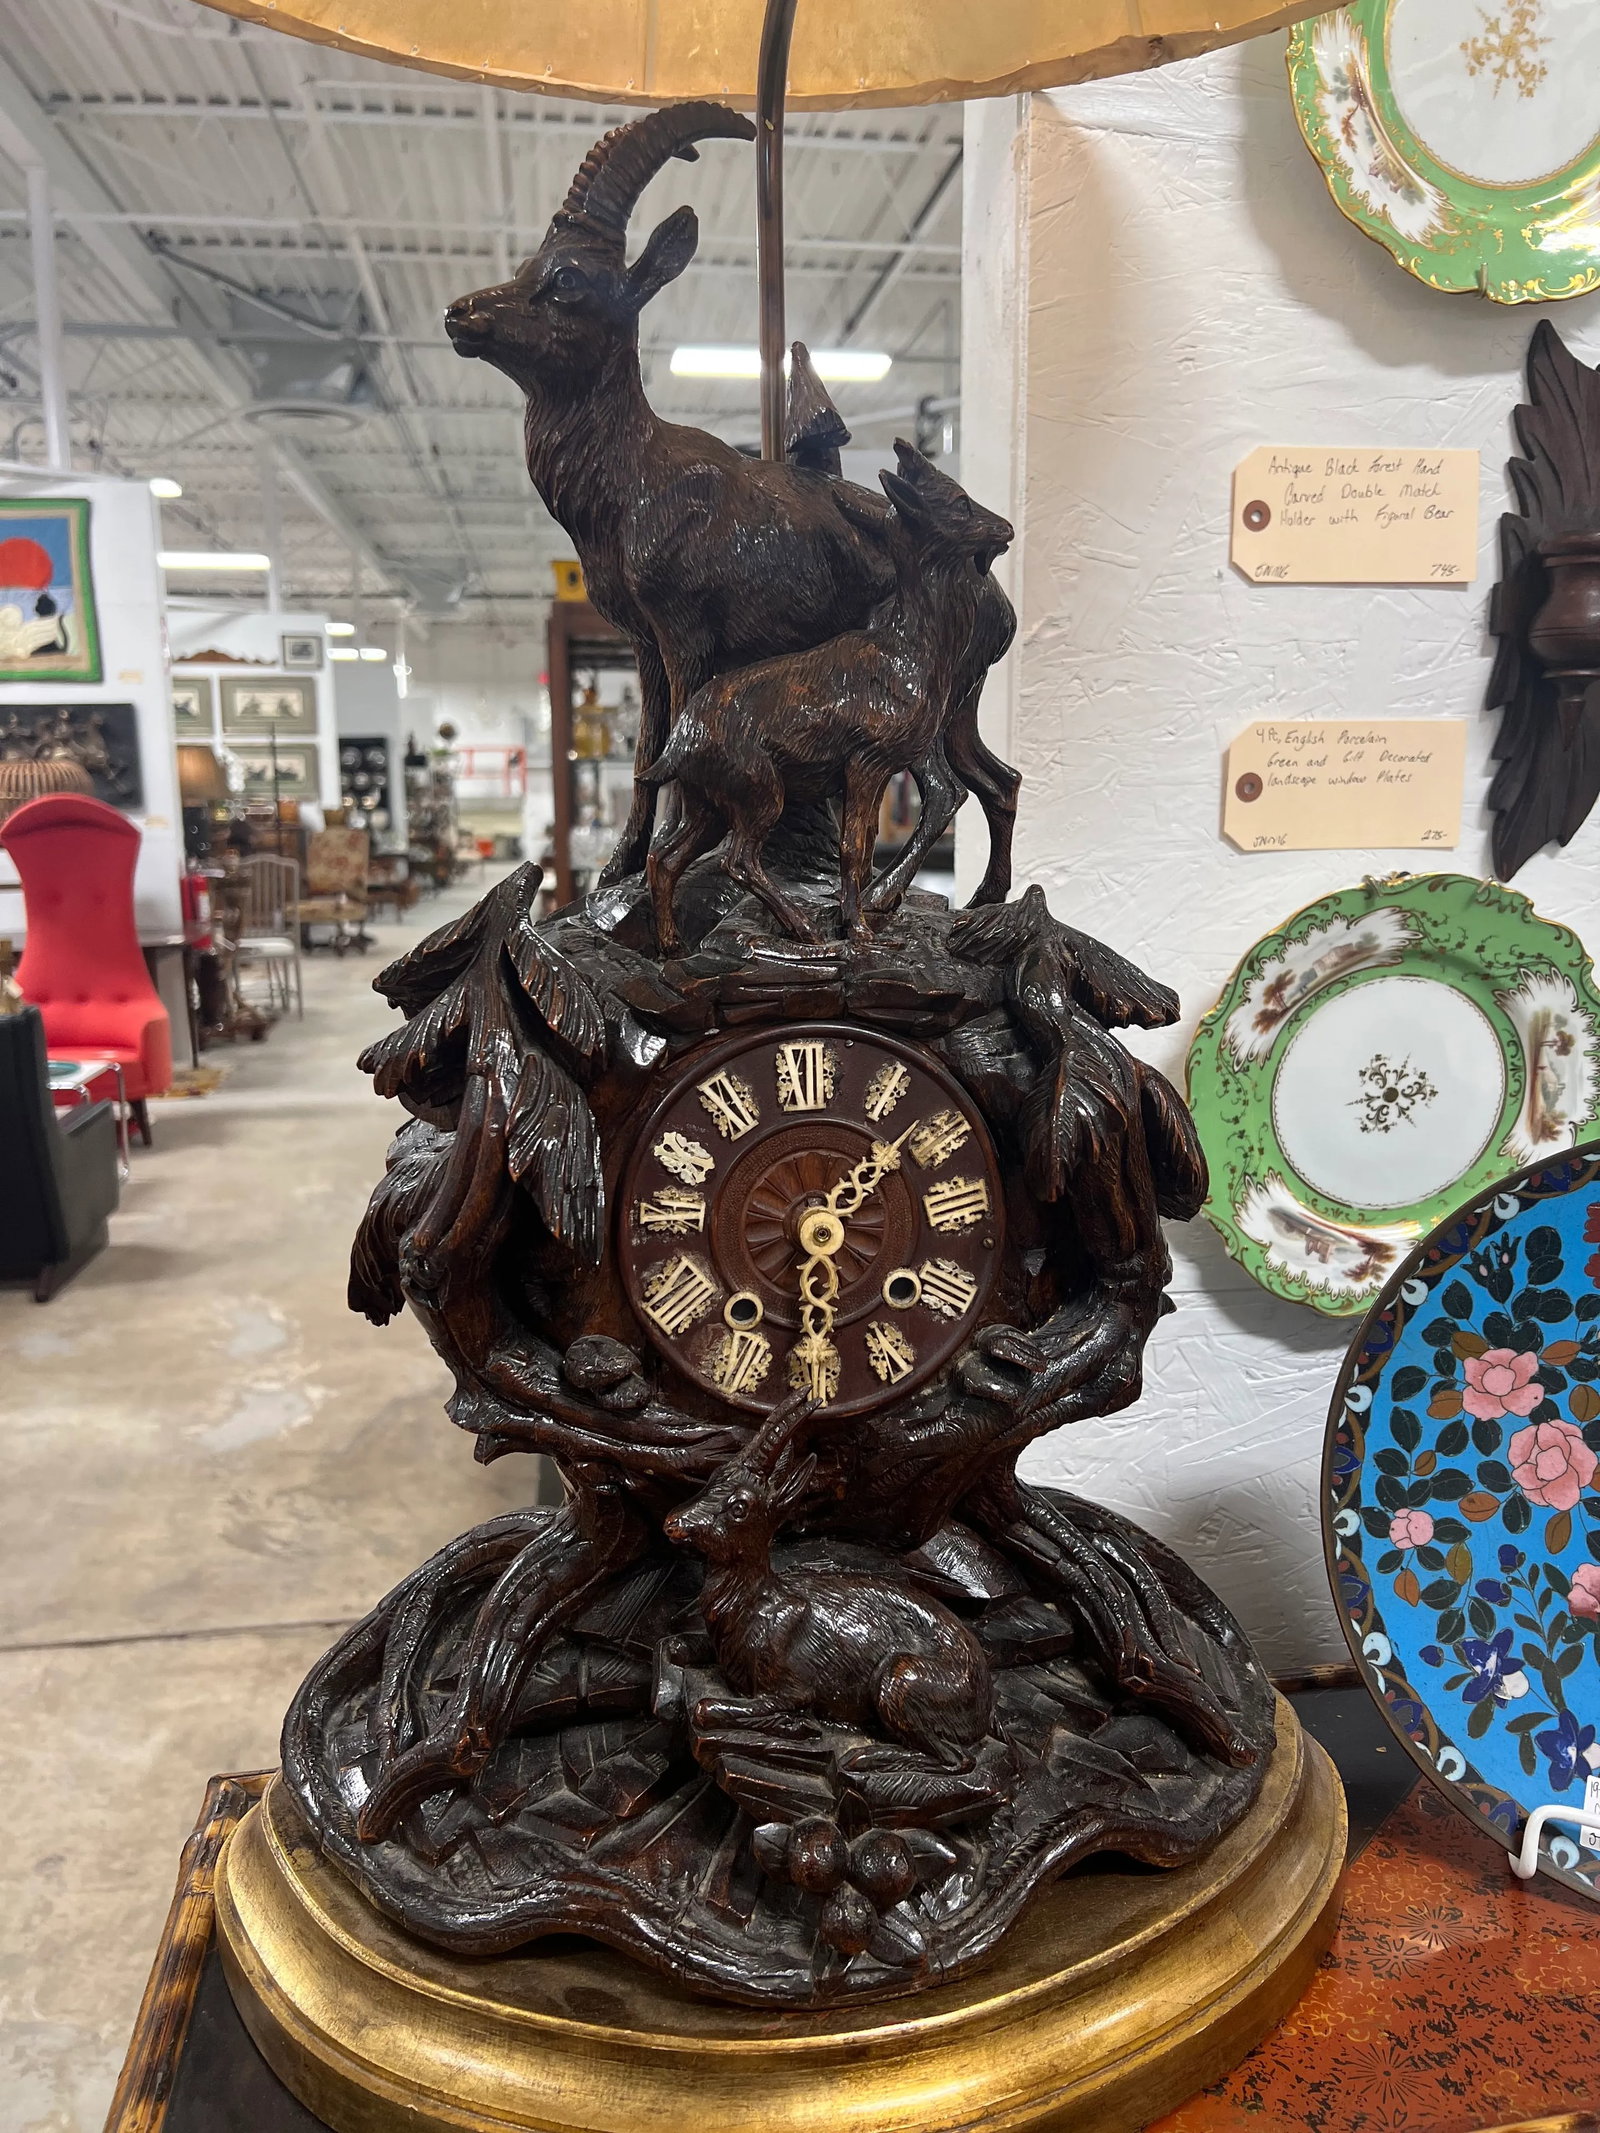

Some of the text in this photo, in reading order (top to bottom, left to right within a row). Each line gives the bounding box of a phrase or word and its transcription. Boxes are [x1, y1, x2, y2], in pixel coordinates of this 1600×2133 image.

[1268, 454, 1444, 478] Antique Black Forest Hand
[1284, 482, 1441, 506] Carved Double Match
[1280, 504, 1454, 529] Holder with Figural Bear
[1256, 728, 1265, 744] 4
[1285, 729, 1325, 752] English
[1337, 729, 1387, 745] Porcelain
[1267, 749, 1433, 768] Green and Gilt Decorated
[1376, 769, 1412, 784] Plates
[779, 1042, 828, 1113] XII
[697, 1070, 760, 1142] XI
